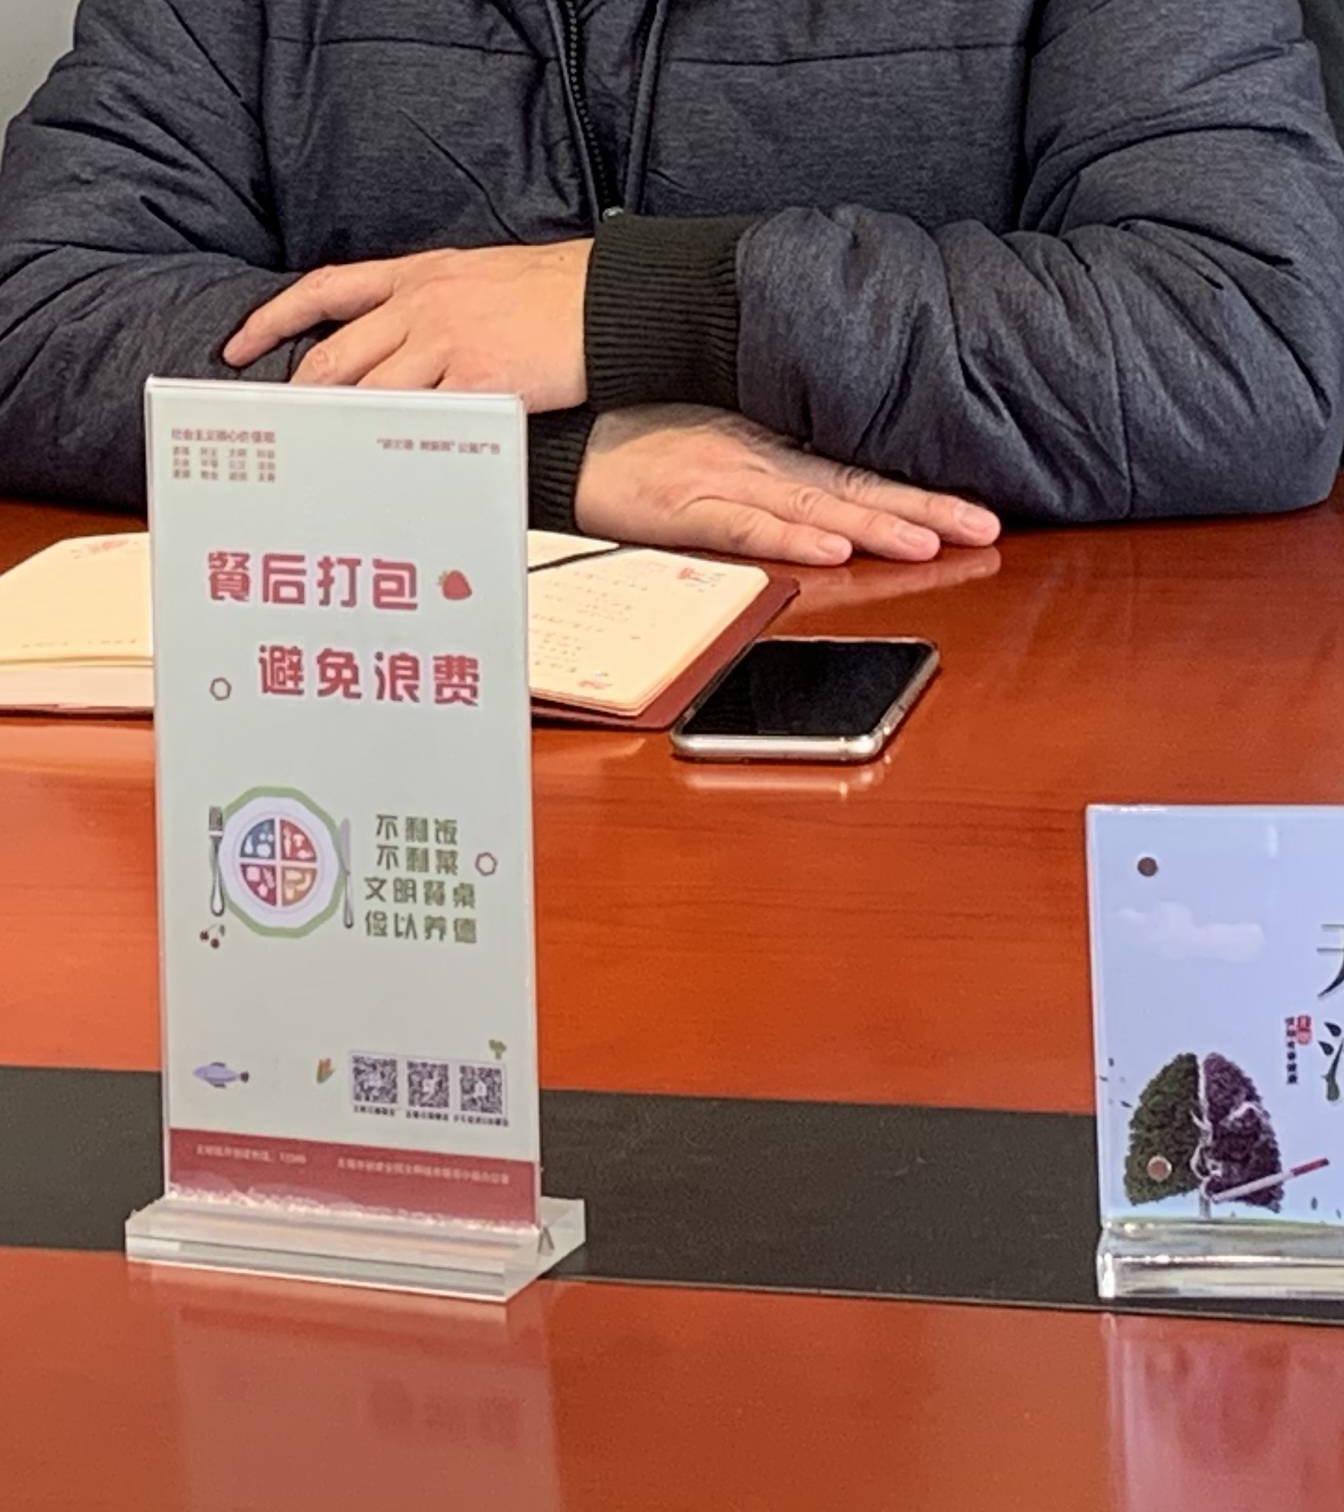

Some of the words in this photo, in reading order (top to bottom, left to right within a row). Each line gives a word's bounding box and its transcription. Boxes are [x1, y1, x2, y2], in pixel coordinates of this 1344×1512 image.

[207, 550, 419, 612] 餐后打包
[258, 644, 481, 707] 避免浪费
[375, 814, 458, 846] 不剩饭
[375, 844, 460, 876] 不剩菜
[364, 876, 476, 910] 文明餐桌
[364, 909, 478, 944] 俭以养德
